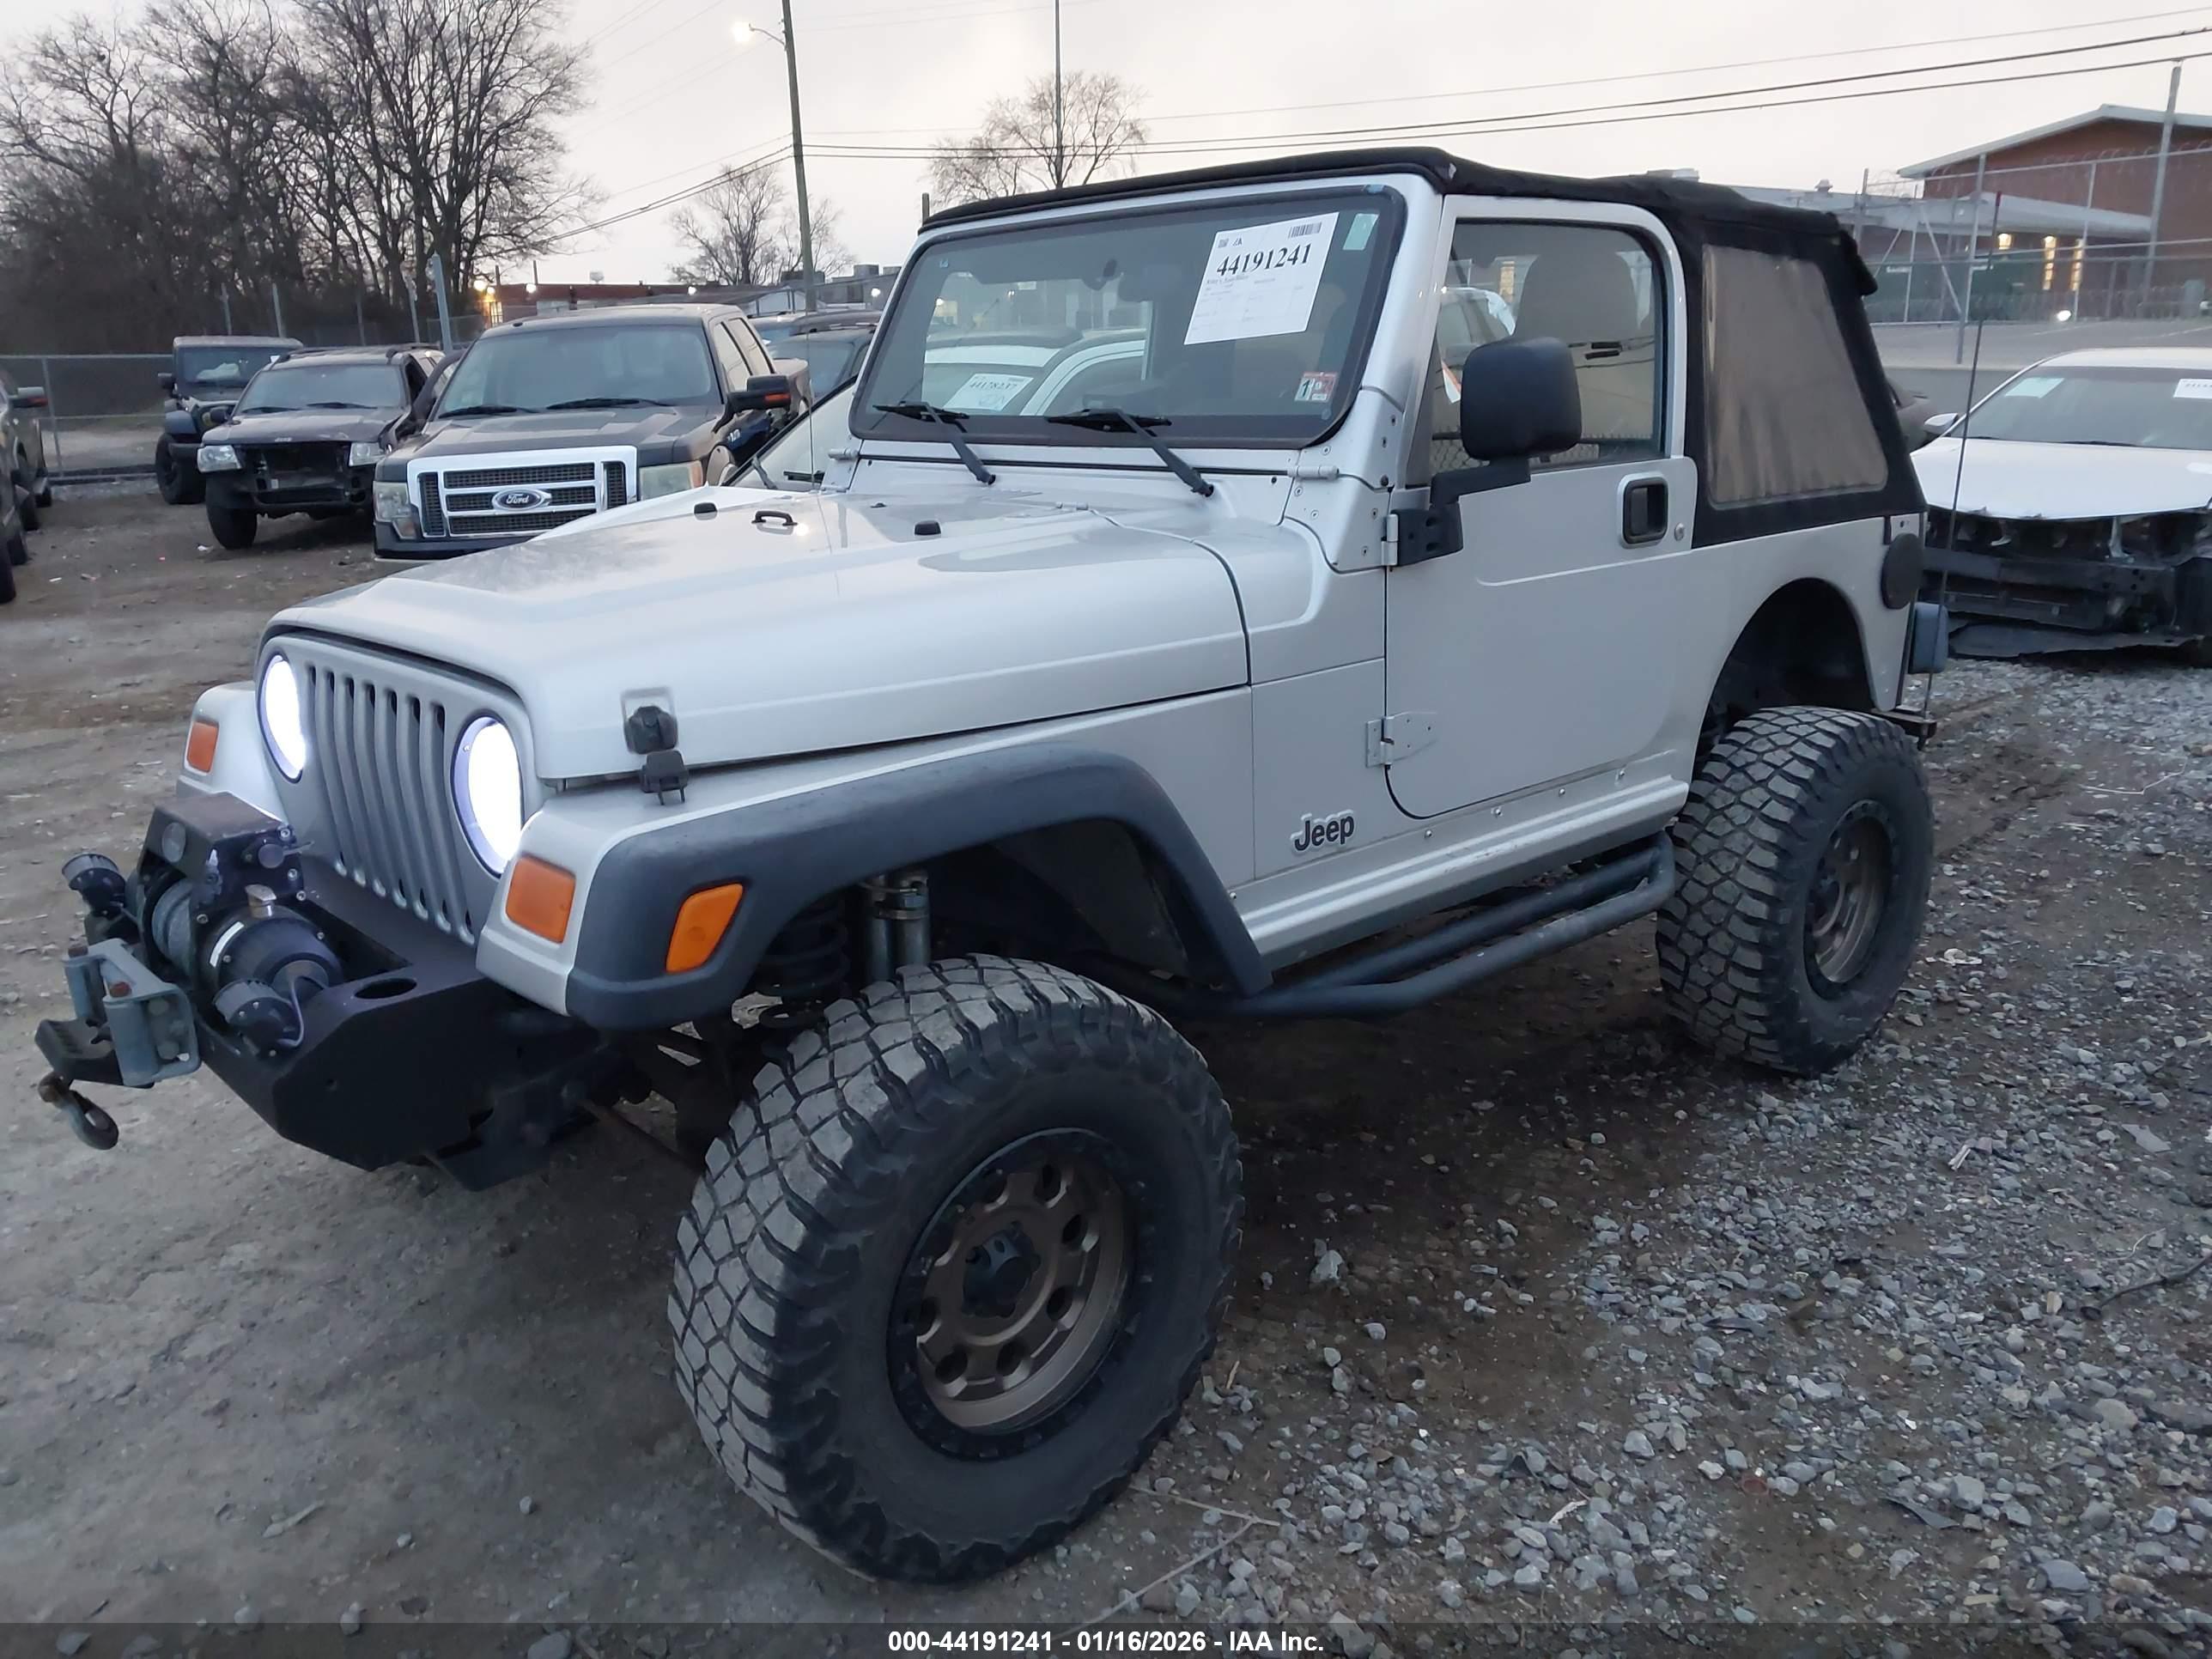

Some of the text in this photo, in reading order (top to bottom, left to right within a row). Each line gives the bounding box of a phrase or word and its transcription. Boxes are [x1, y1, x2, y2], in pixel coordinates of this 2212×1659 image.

[1216, 242, 1312, 276] 44191241
[505, 493, 530, 504] Ford
[1293, 814, 1356, 852] Jeep
